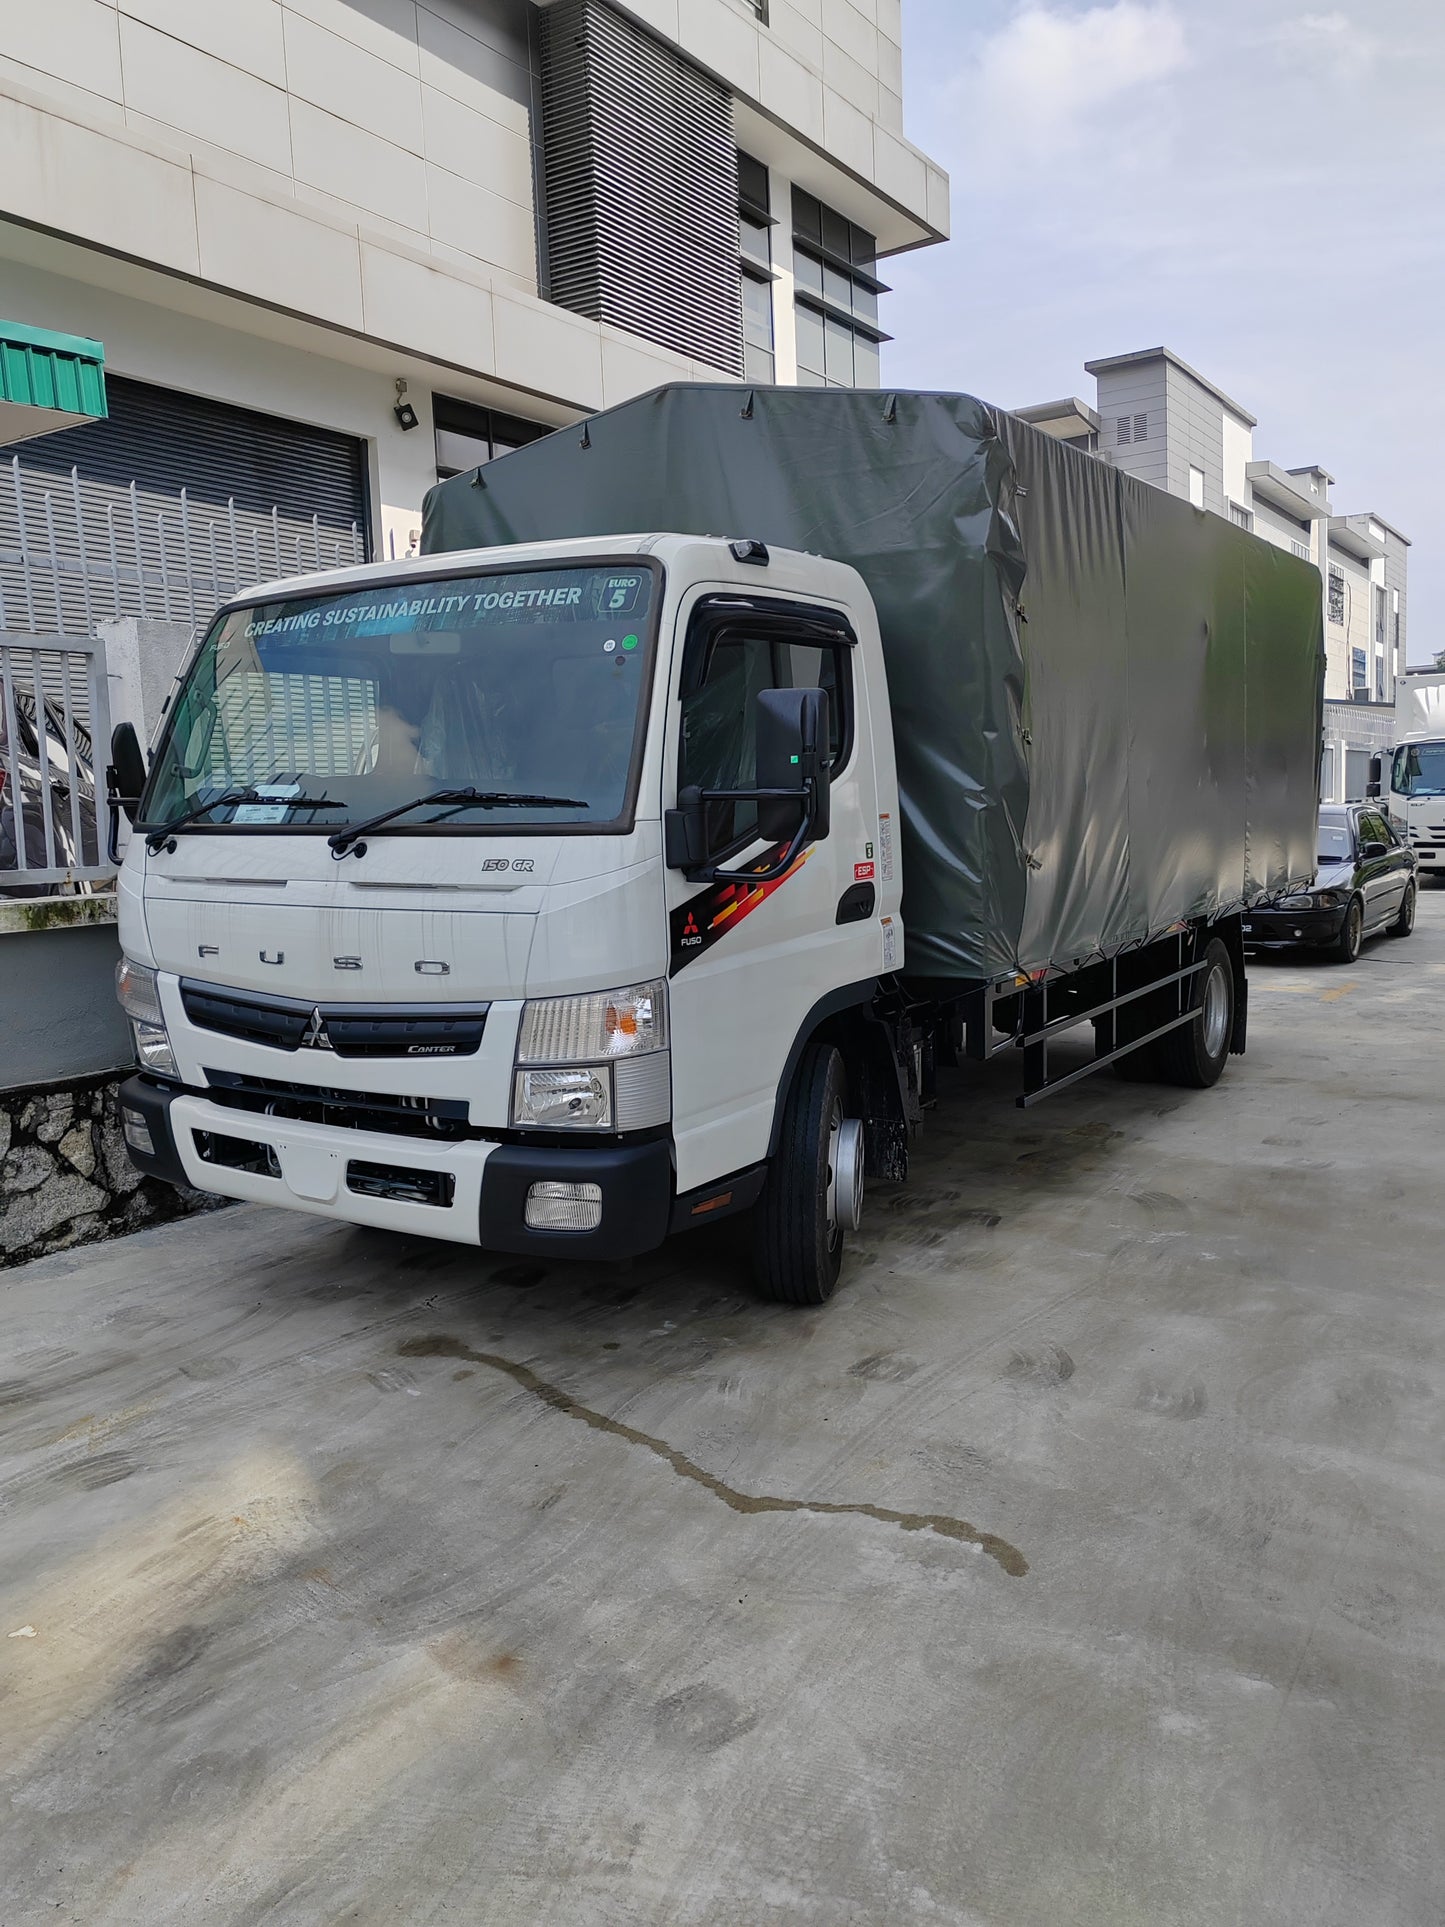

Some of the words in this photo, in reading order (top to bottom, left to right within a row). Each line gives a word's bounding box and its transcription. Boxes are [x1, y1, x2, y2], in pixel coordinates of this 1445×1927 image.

[608, 578, 637, 588] EURO
[608, 588, 627, 609] 5
[244, 613, 320, 638] CREATING
[322, 595, 471, 626] SUSTAINABILITY
[473, 587, 582, 611] TOGETHER
[481, 858, 510, 871] 150
[511, 858, 535, 872] GR
[680, 936, 702, 947] FUSO
[197, 944, 450, 976] FUSO
[407, 1045, 456, 1054] CANTER
